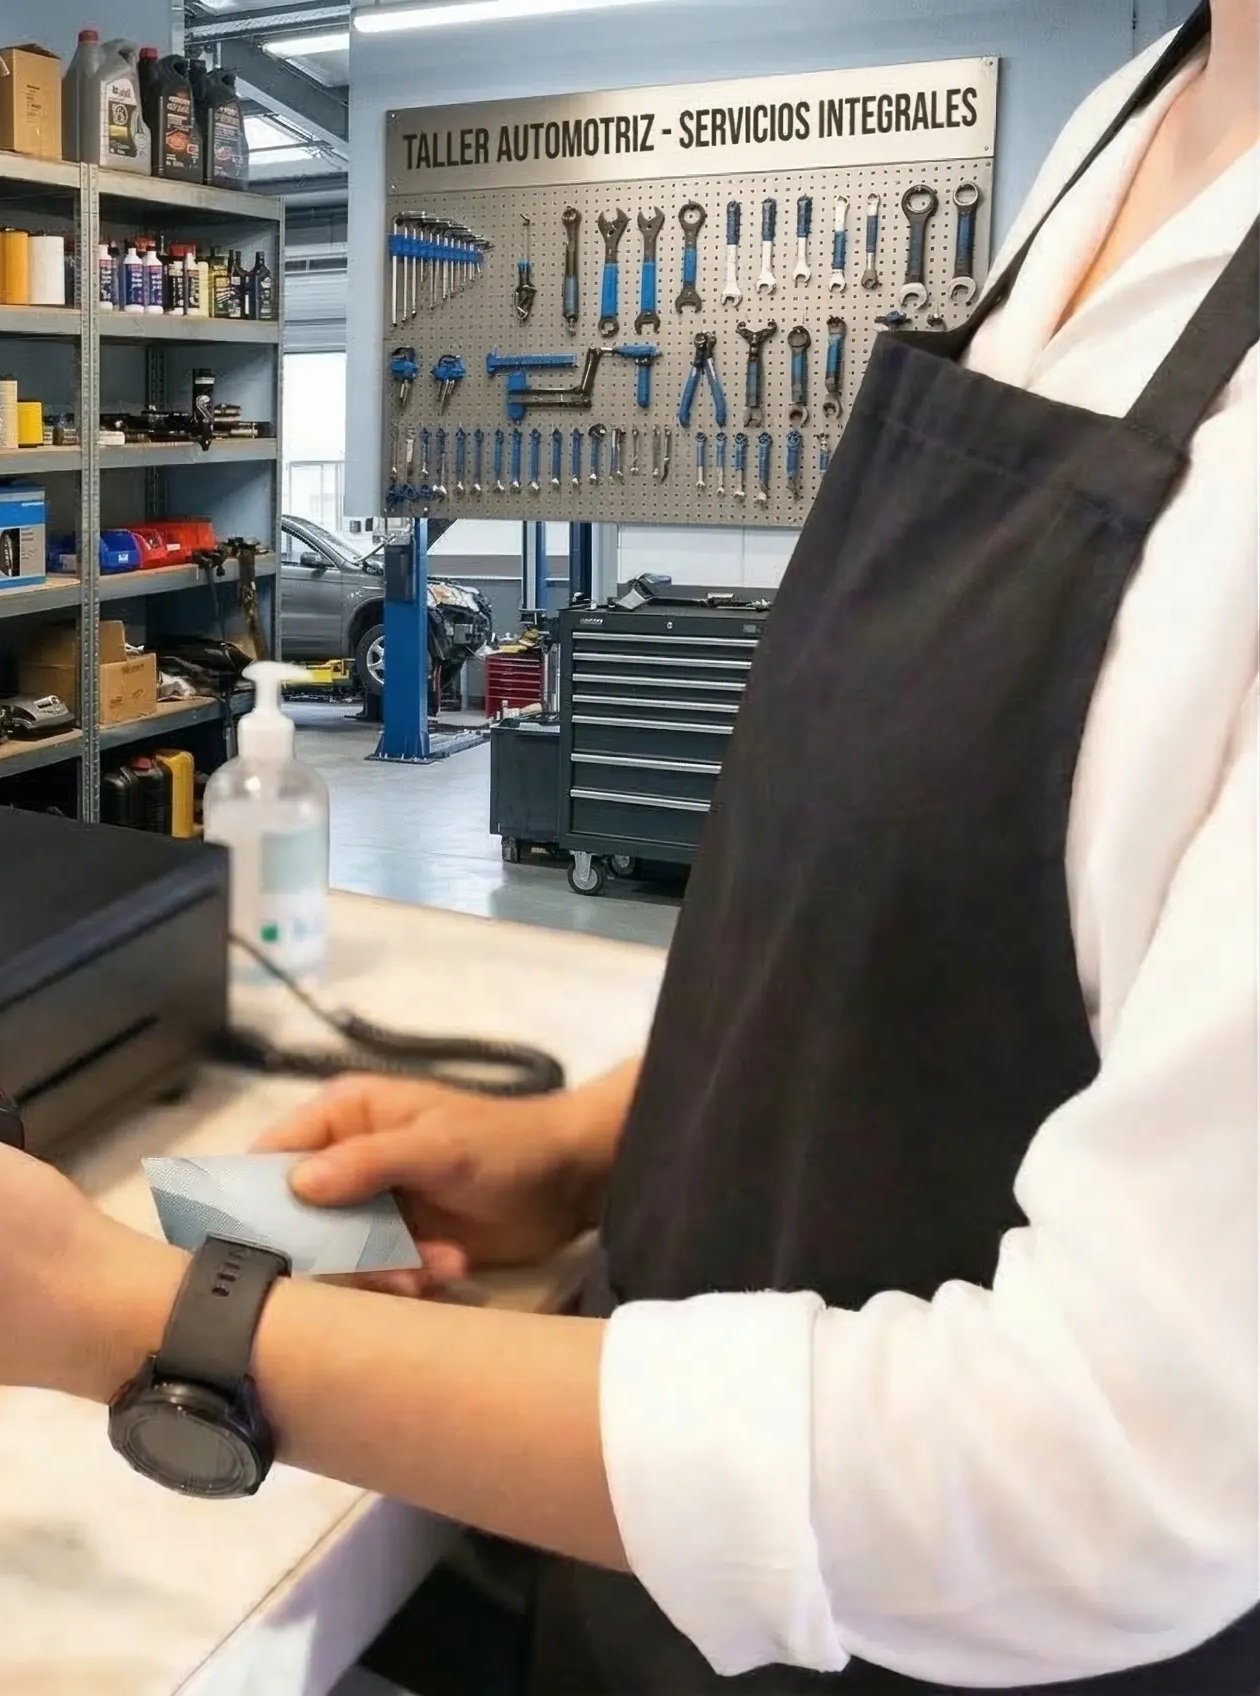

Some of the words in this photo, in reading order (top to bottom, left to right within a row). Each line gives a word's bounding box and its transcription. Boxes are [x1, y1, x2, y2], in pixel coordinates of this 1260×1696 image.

[403, 126, 489, 170] TALLER
[497, 114, 655, 162] AUTOMOTRIZ
[679, 102, 810, 148] SERVICIOS
[819, 87, 978, 137] INTEGRALES
